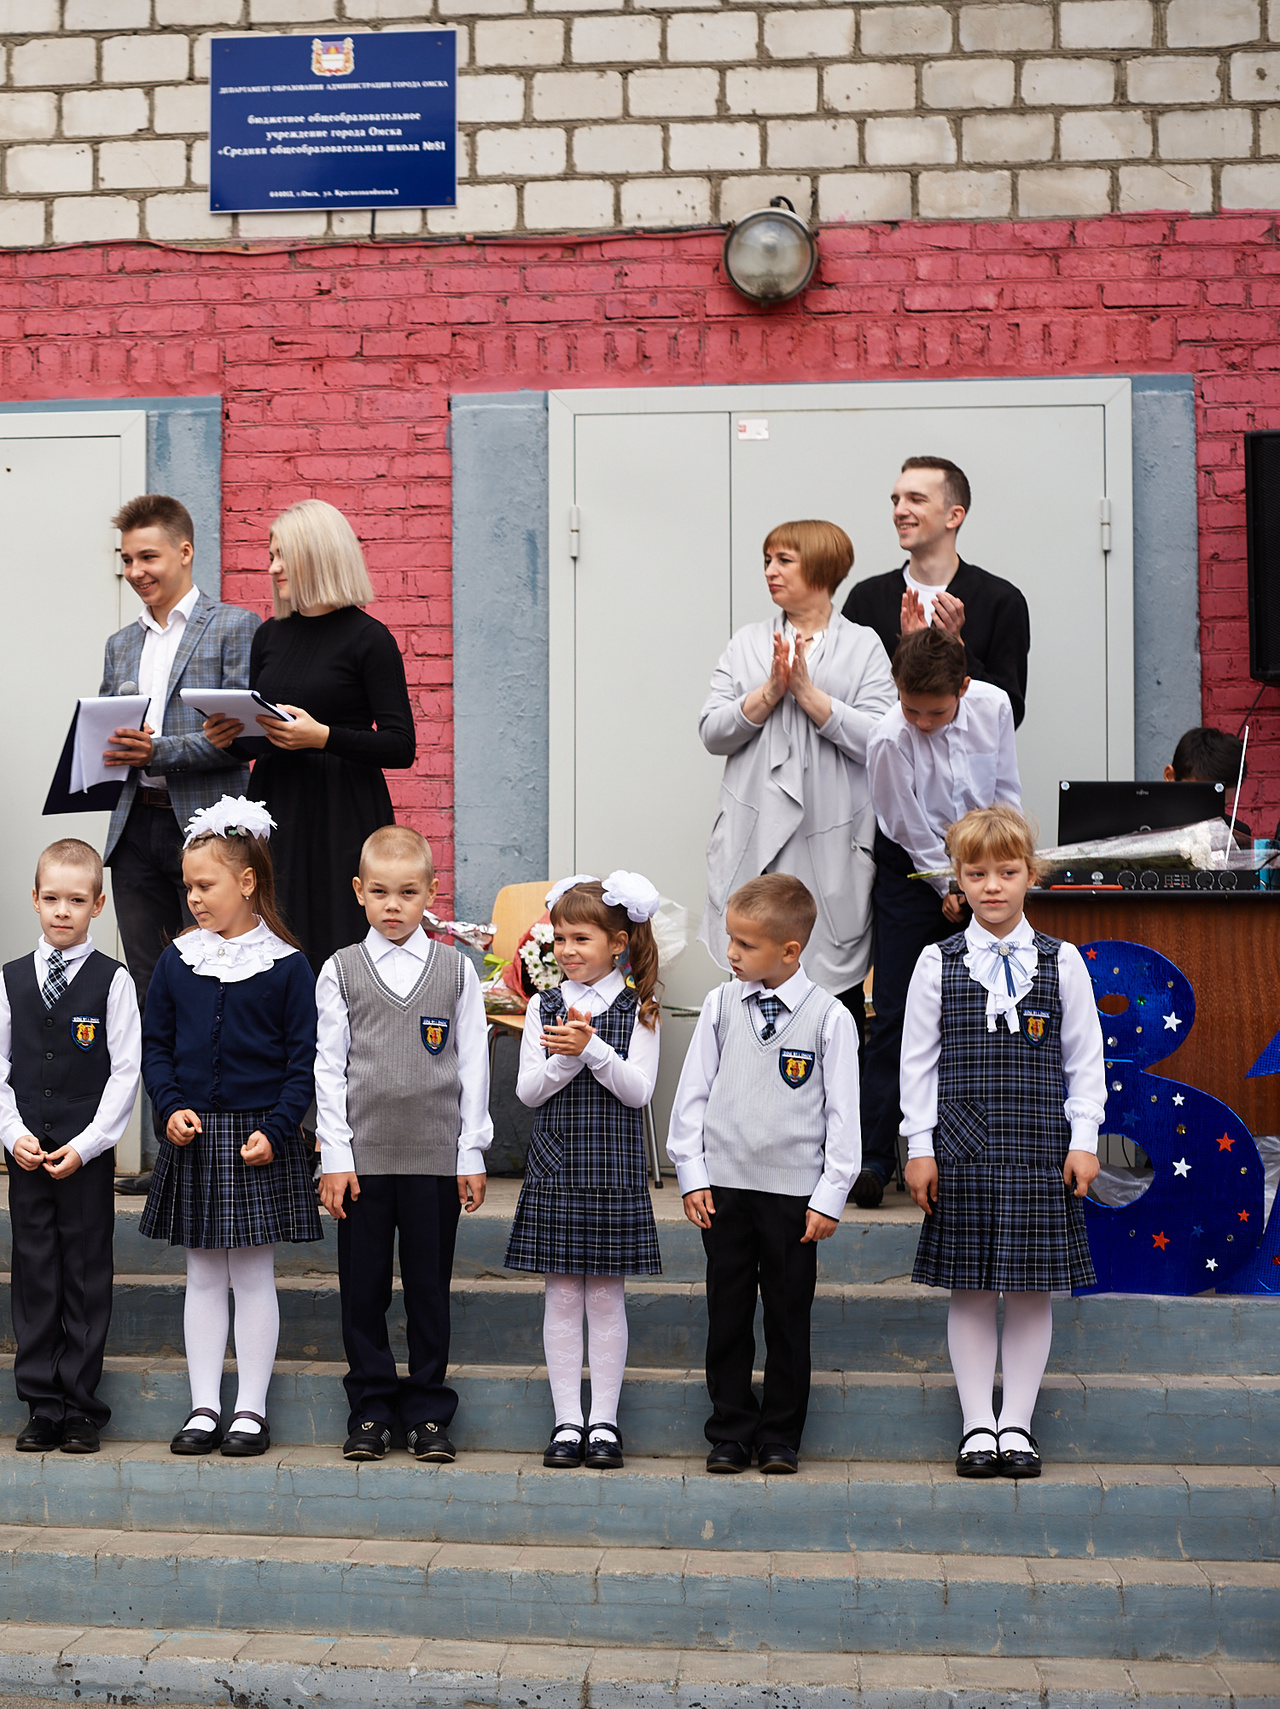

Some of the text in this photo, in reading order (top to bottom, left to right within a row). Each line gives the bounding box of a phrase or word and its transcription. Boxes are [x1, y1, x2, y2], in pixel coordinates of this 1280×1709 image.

[219, 86, 271, 94] ДЕПАРТАМЕНТ
[326, 82, 392, 90] АДМИНИСТРАЦИИ
[247, 112, 421, 124] бюджетное общеобразовательное
[266, 127, 402, 141] учреждение города Омска
[218, 146, 267, 158] «Средняя
[269, 144, 383, 156] общеобразовательная
